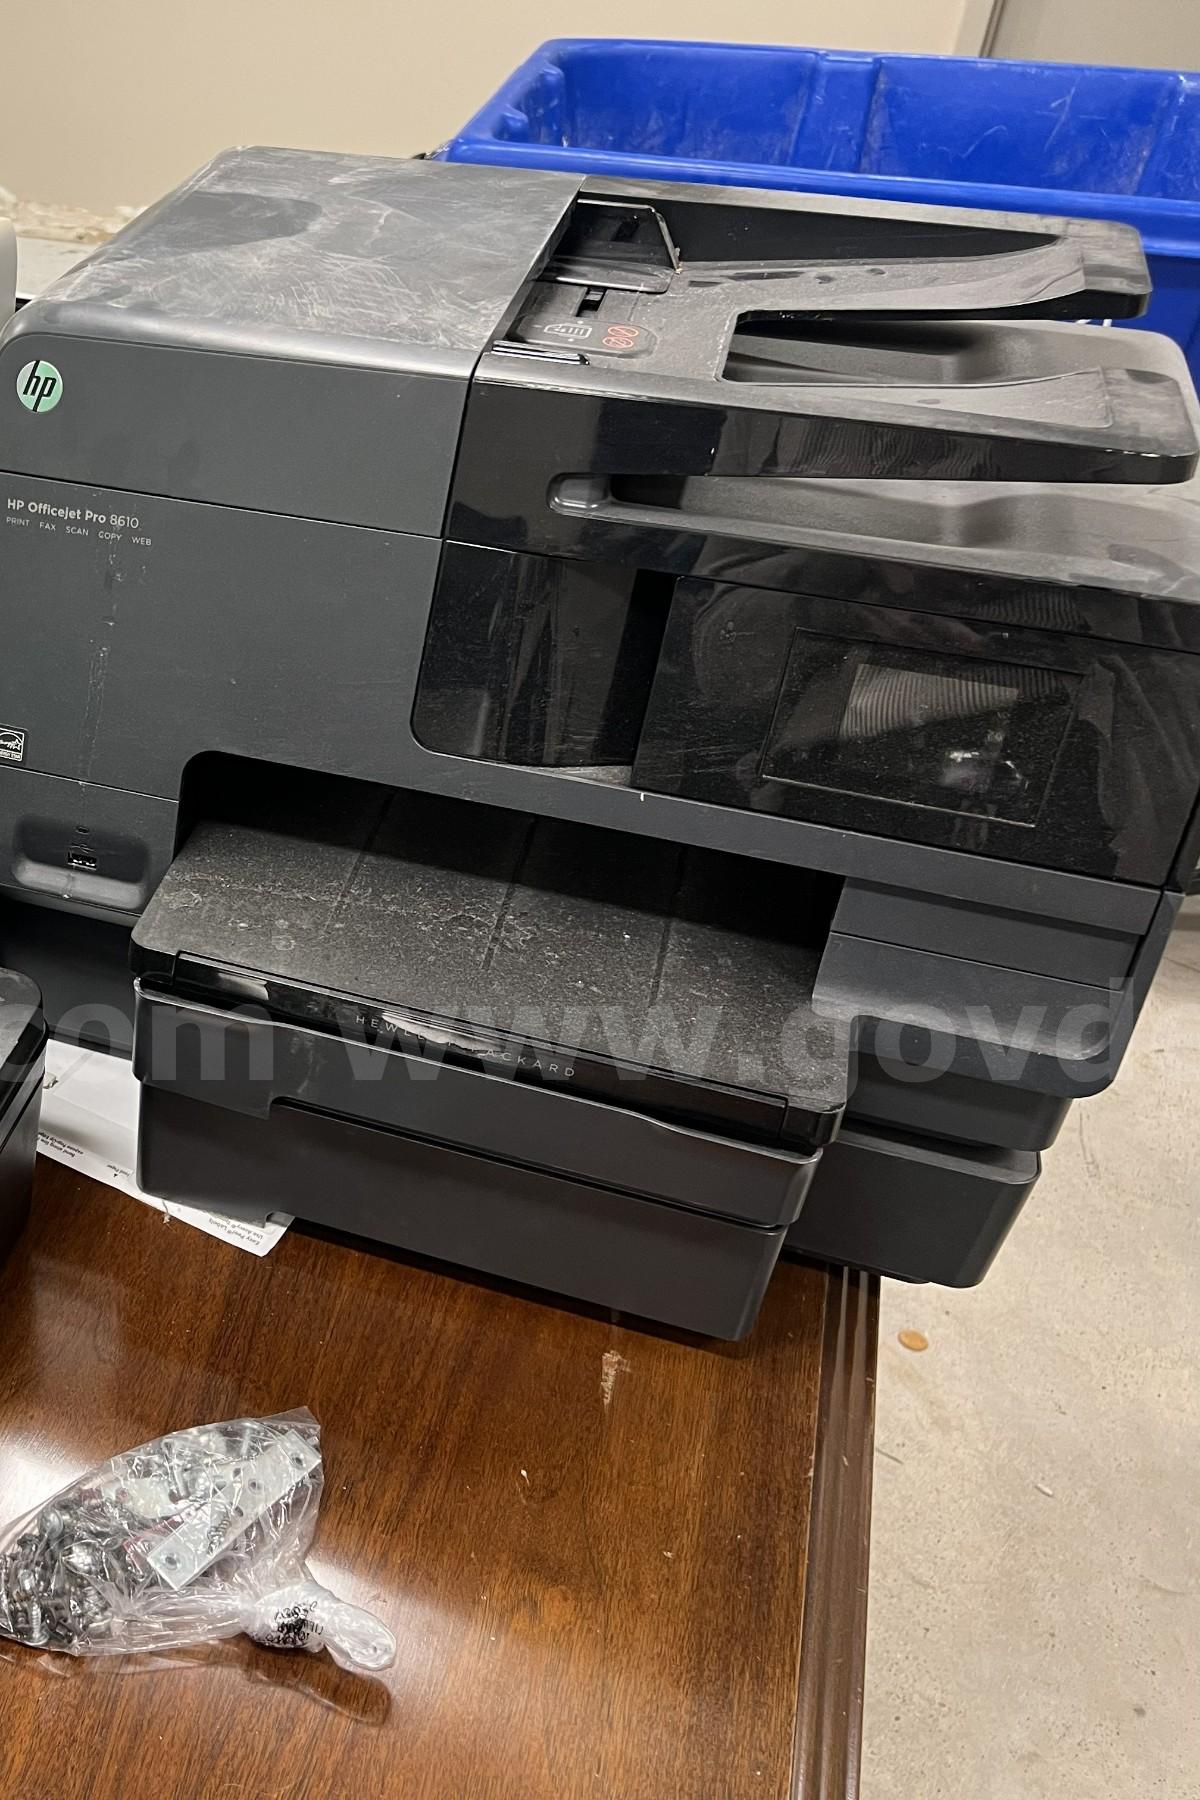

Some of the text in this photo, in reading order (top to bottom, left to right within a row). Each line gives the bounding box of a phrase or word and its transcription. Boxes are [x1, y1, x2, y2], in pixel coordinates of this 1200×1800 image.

[21, 360, 58, 412] hp
[7, 498, 139, 528] HP Officejet Pro 8610
[6, 516, 152, 546] PRINT FAX SCAN COPY WEB
[472, 1048, 575, 1077] ACKARD
